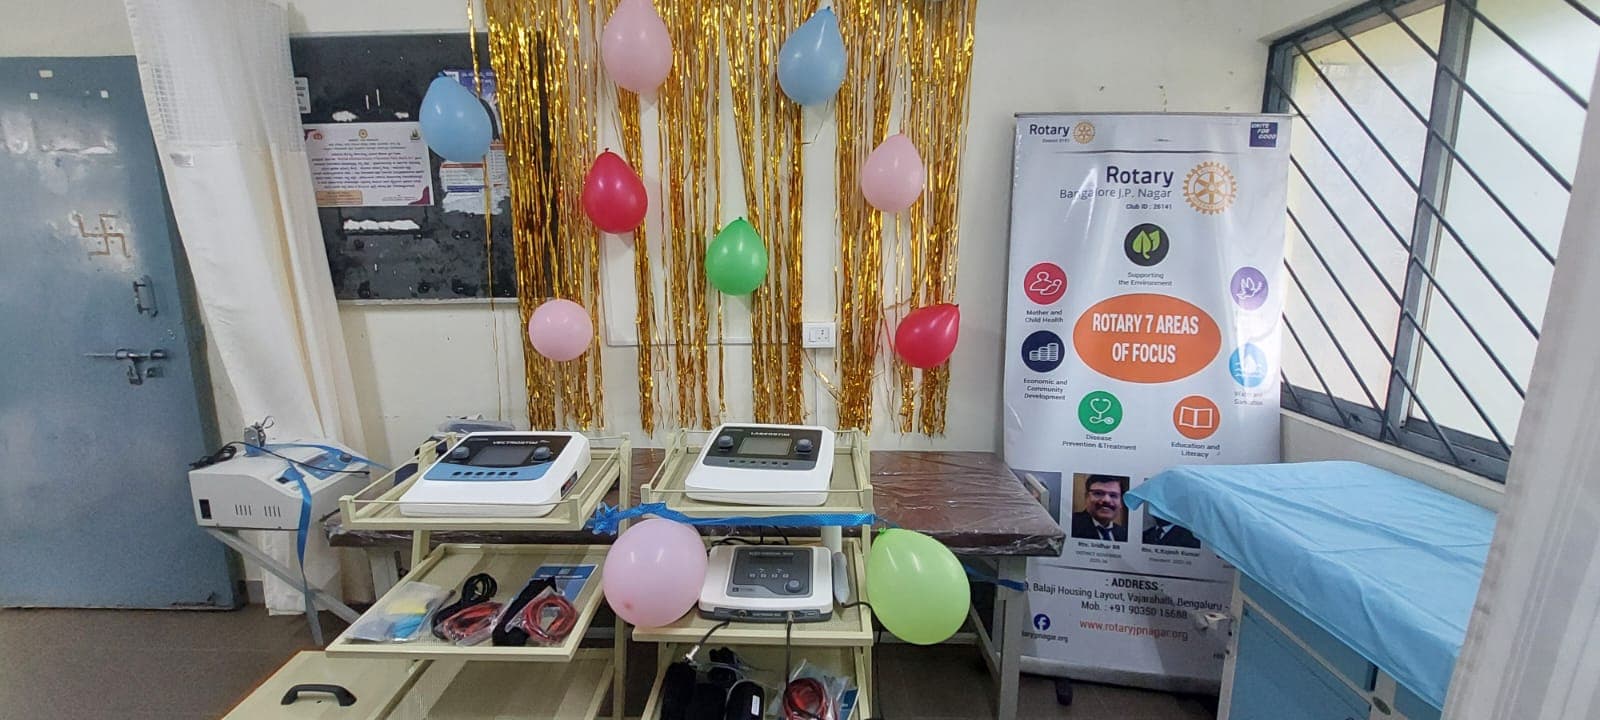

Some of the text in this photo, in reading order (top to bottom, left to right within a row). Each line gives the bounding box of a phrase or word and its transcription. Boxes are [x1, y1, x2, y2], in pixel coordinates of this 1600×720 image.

[1030, 124, 1070, 137] Rotary
[1106, 166, 1174, 187] Rotary
[1060, 189, 1116, 200] Bangalore
[1138, 189, 1172, 200] Nagar
[1093, 313, 1199, 335] ROTARY 7 AREAS
[1112, 342, 1176, 363] OF FOCUS
[1171, 441, 1205, 449] Education
[1181, 450, 1209, 458] Literacy
[1111, 578, 1160, 592] ADDRESS
[1033, 582, 1056, 595] Balaji
[1058, 586, 1092, 599] Housing
[1094, 590, 1125, 602] Layout,
[1177, 597, 1223, 611] Bengaluru
[1109, 604, 1125, 613] +91
[1128, 604, 1157, 617] 90350
[1080, 620, 1189, 642] www.rotaryjpnagar.org
